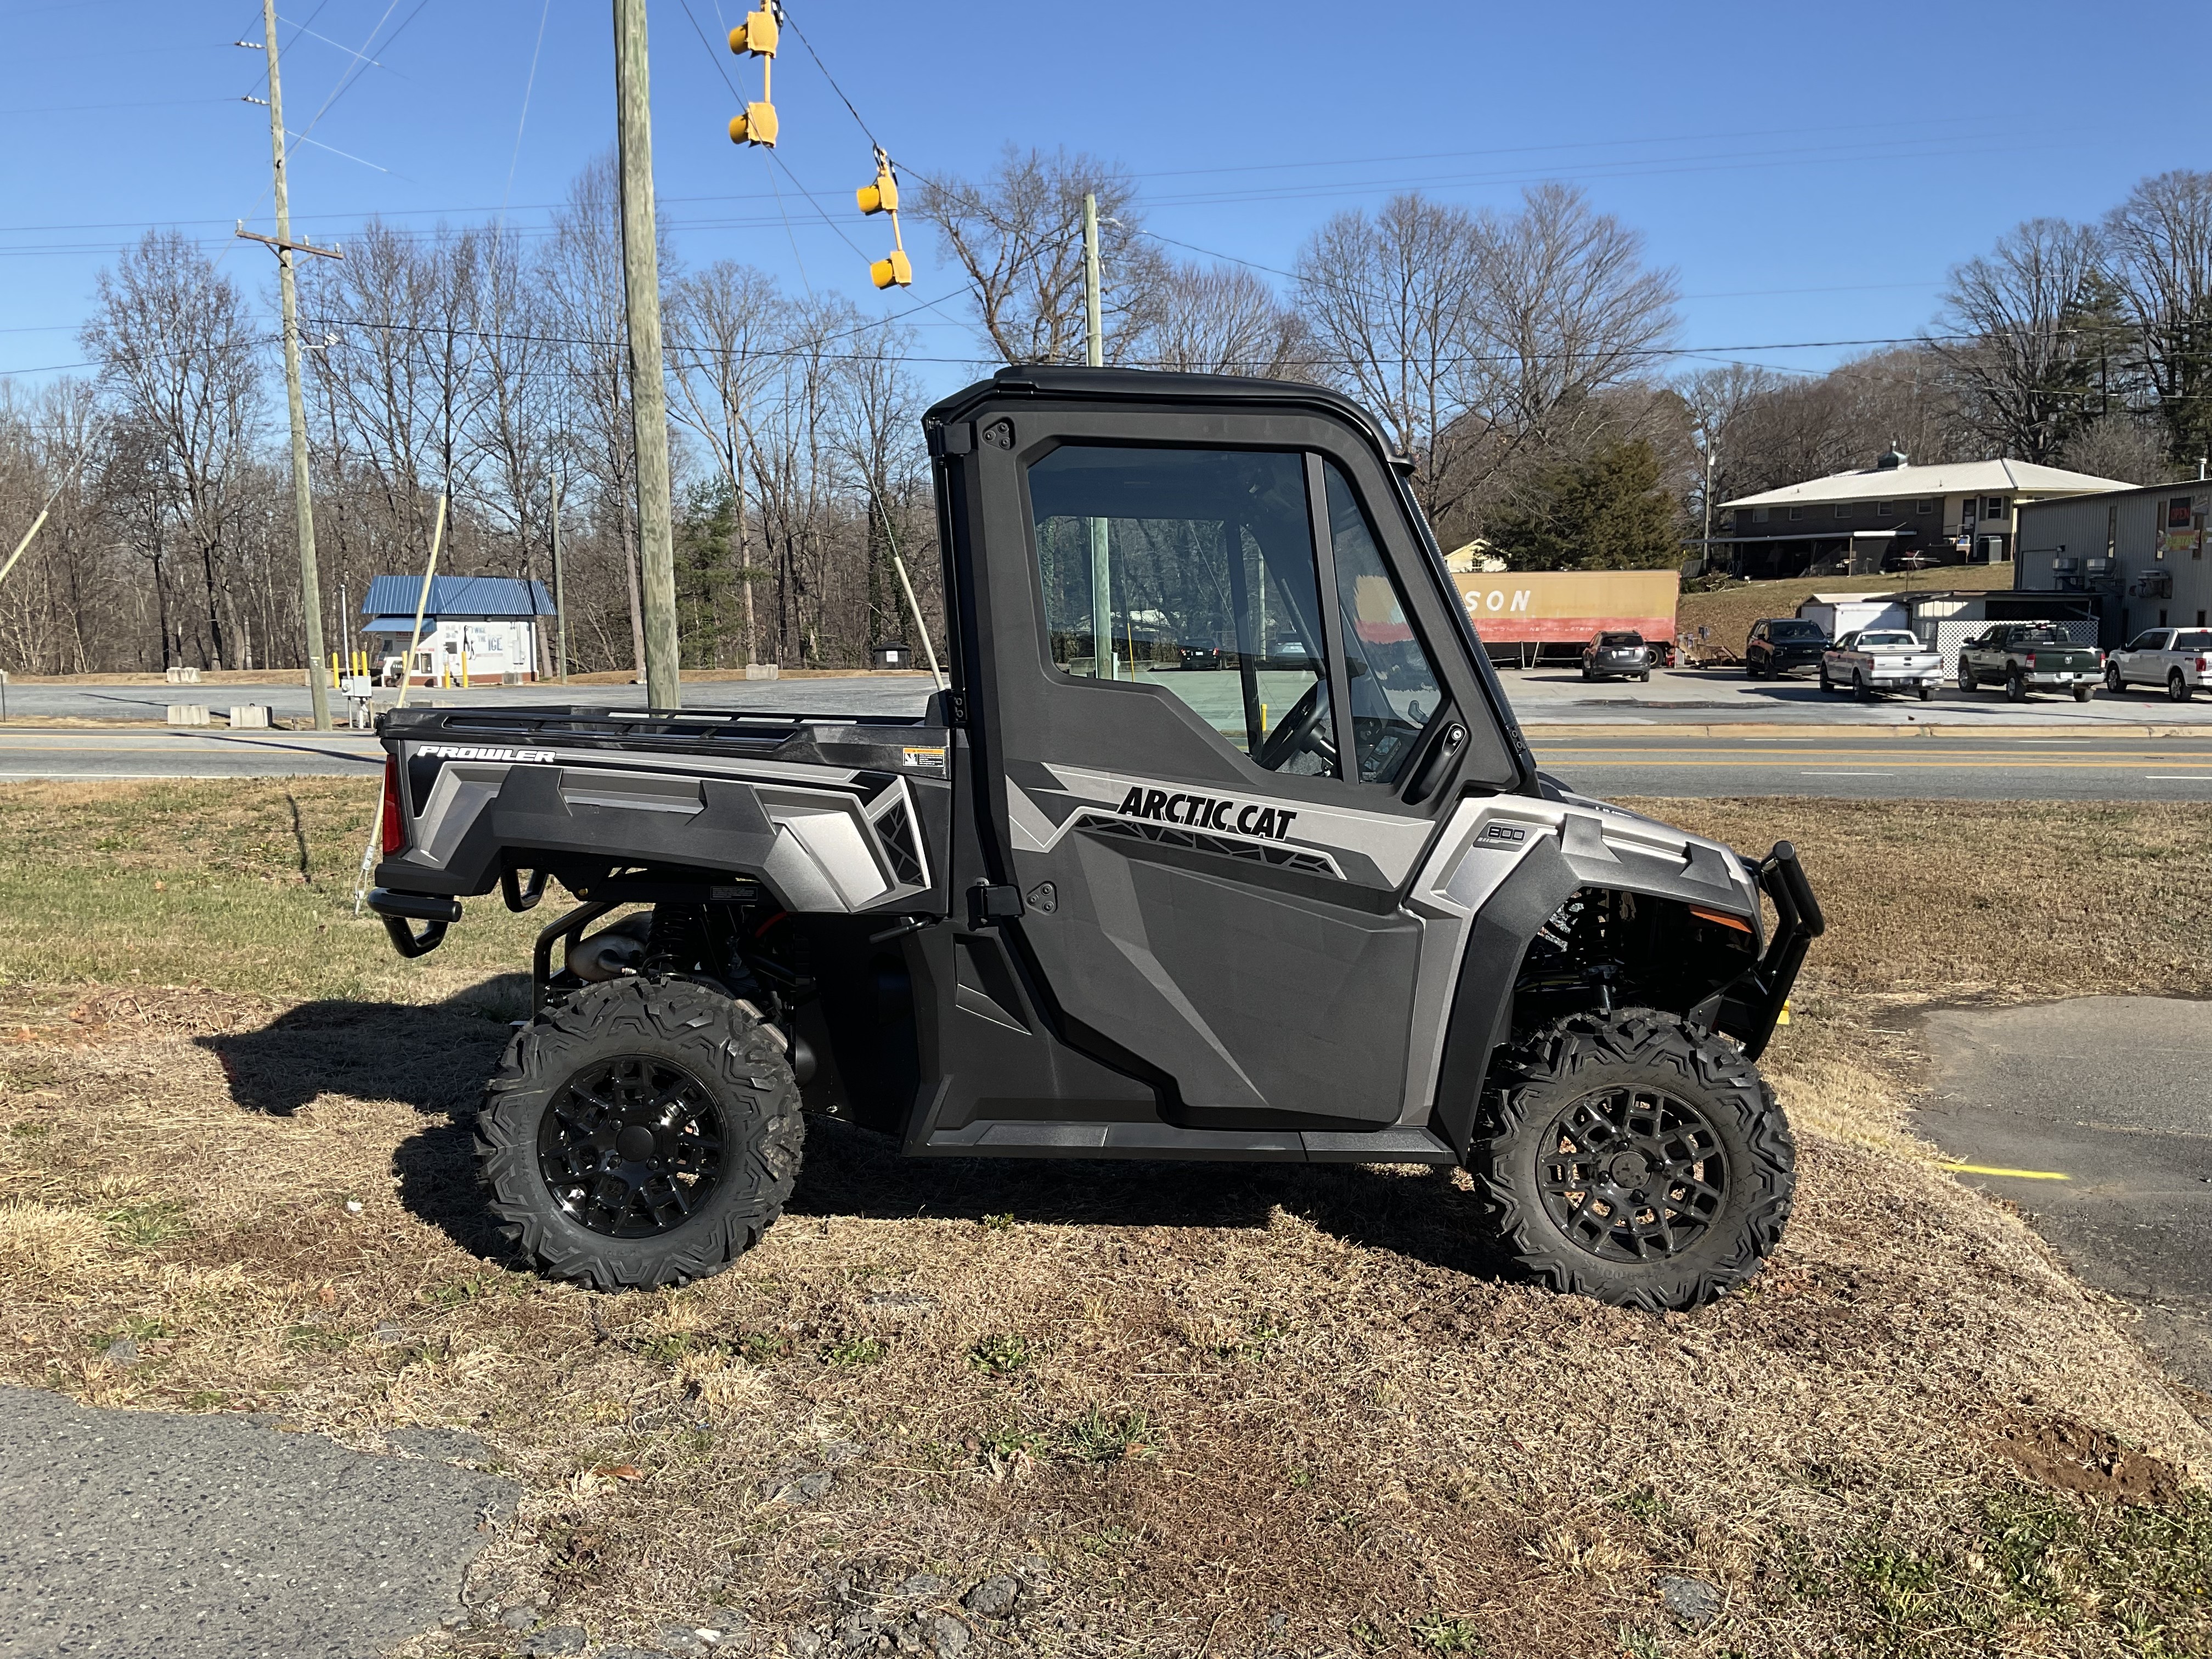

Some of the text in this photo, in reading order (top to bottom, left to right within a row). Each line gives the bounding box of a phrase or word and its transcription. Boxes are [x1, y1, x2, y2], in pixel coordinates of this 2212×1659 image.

[1465, 590, 1531, 612] SON
[488, 637, 503, 651] ICE
[417, 745, 556, 762] PROWLER
[1116, 786, 1297, 840] ARCTIC CAT
[1487, 825, 1525, 841] 800
